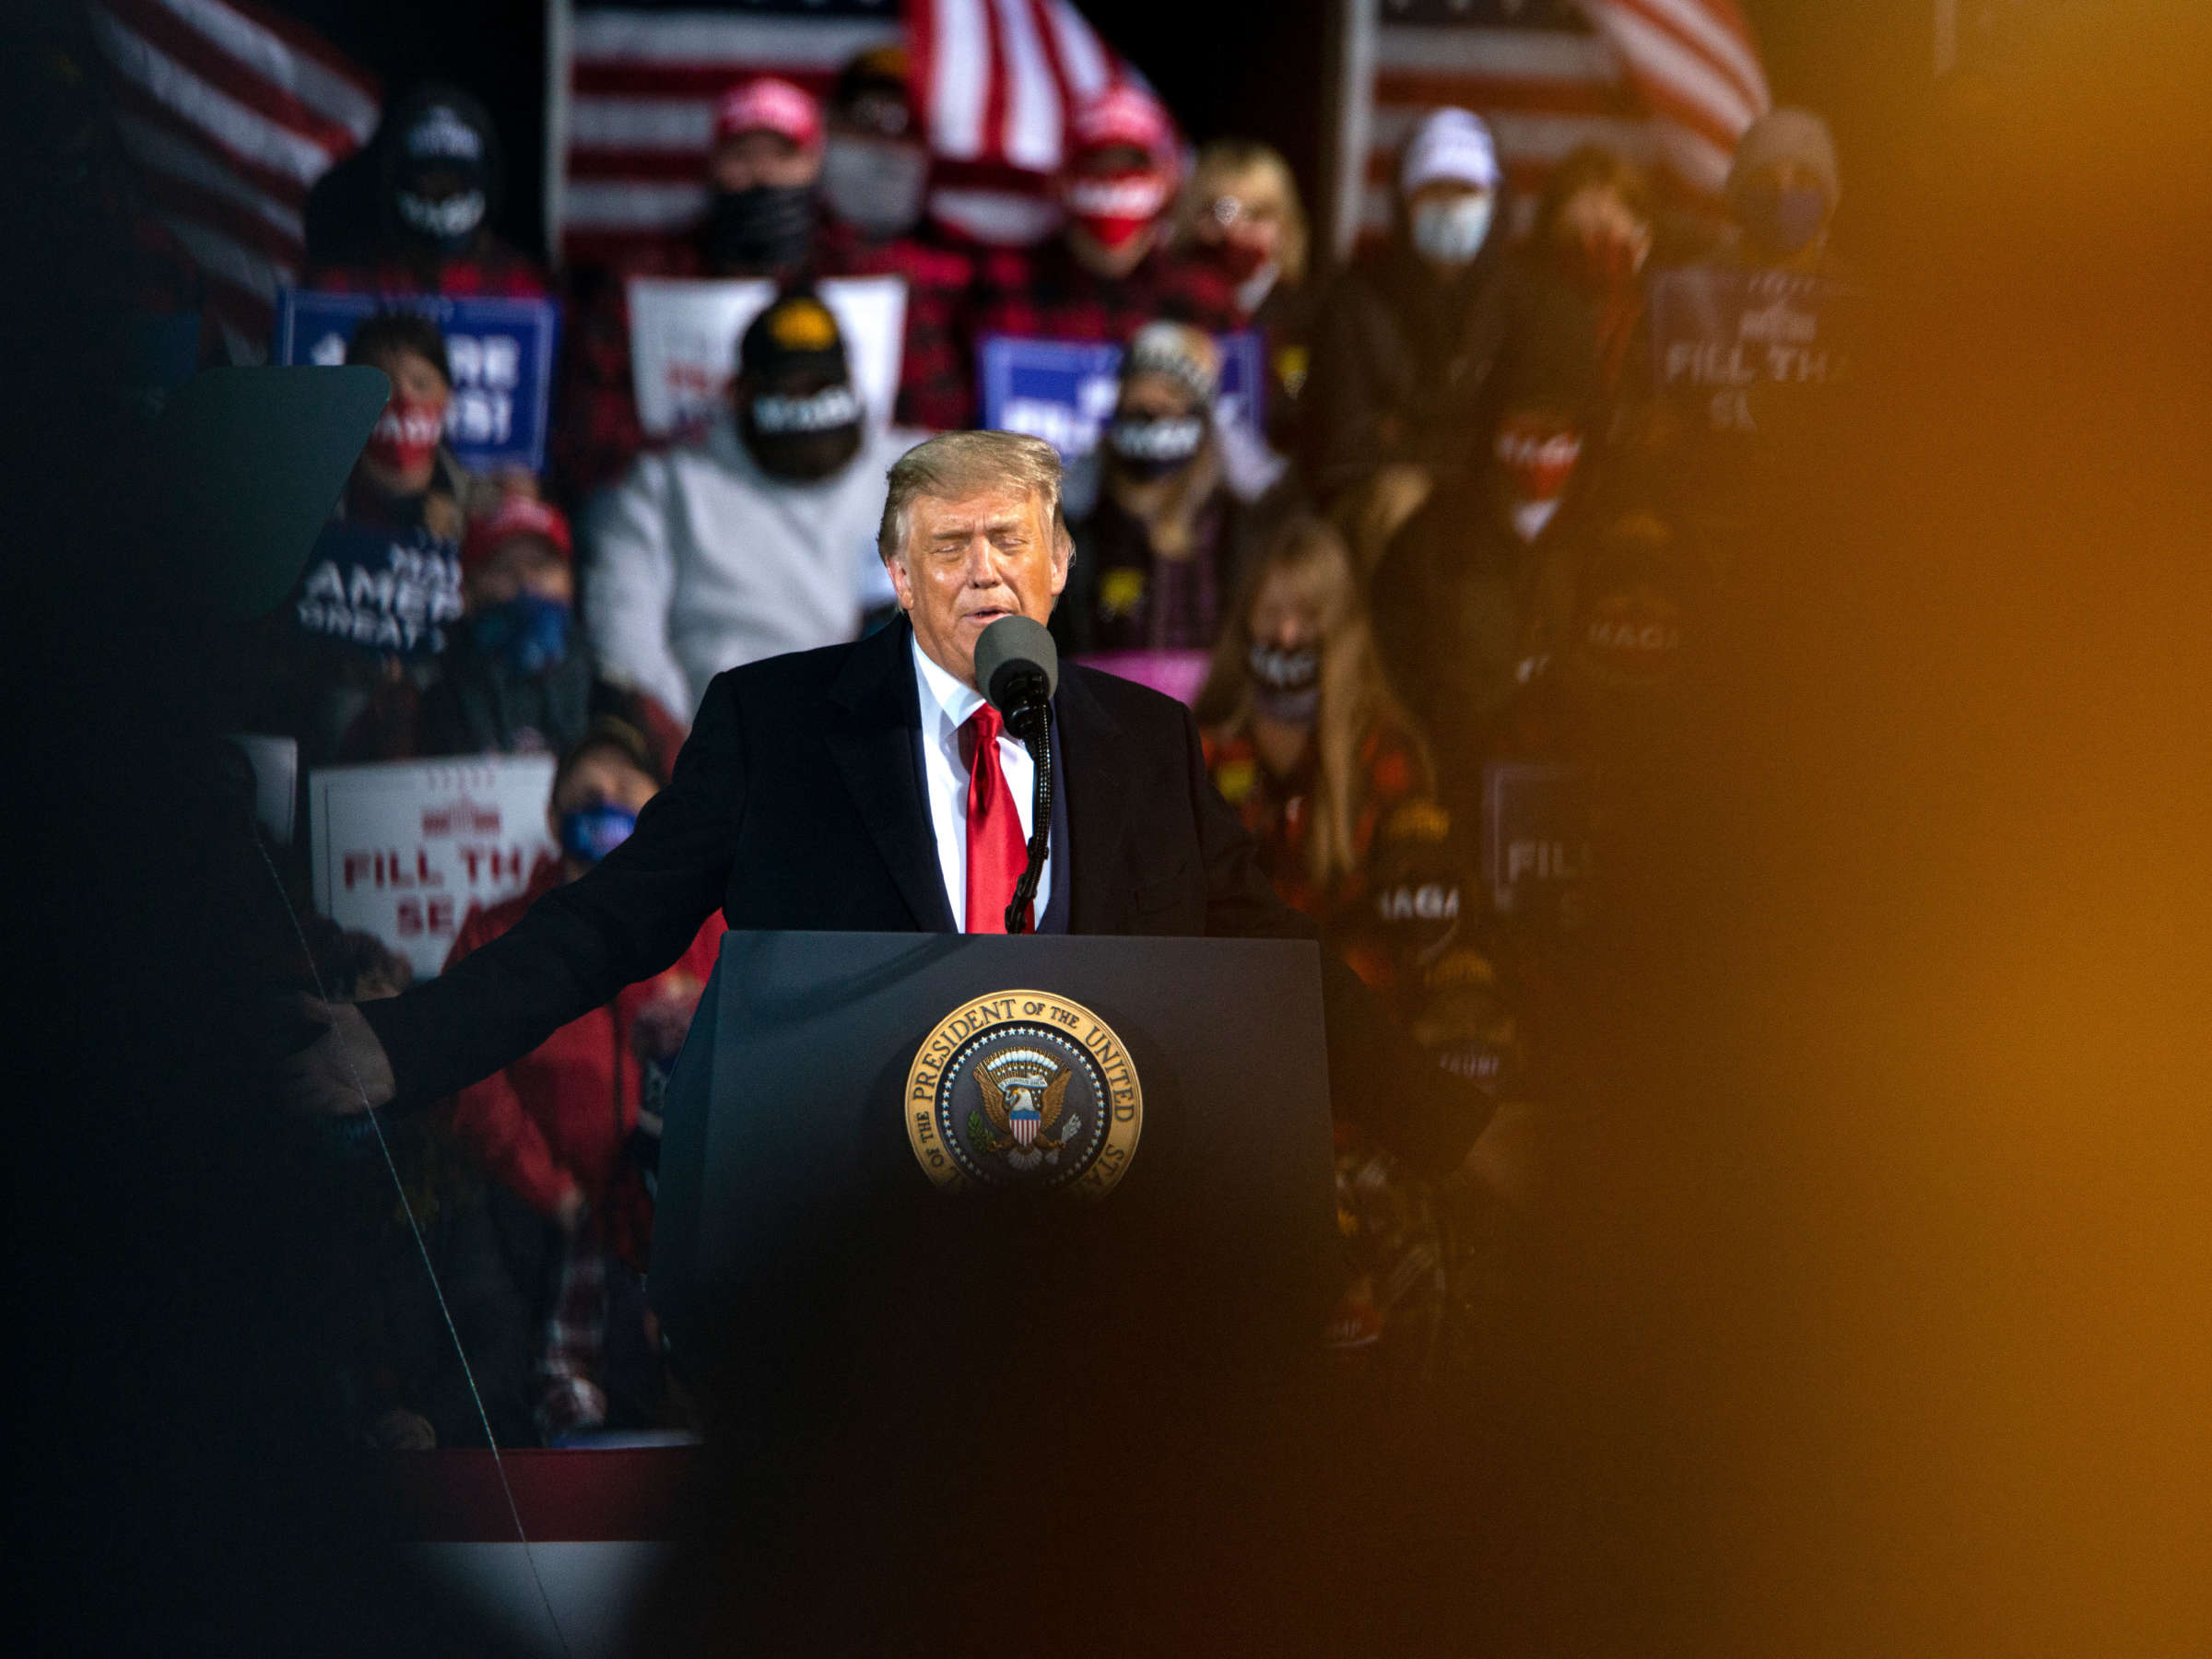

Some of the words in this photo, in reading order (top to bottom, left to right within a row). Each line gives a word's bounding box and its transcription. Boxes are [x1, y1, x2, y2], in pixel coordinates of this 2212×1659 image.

[305, 559, 465, 623] AMER
[344, 848, 443, 890] FILL
[1023, 1001, 1045, 1017] OF
[1050, 1005, 1080, 1030] THE
[912, 998, 1017, 1102] PRESIDENT
[1085, 1025, 1135, 1123] UNITED
[914, 1111, 934, 1144] THE
[926, 1147, 945, 1168] OF
